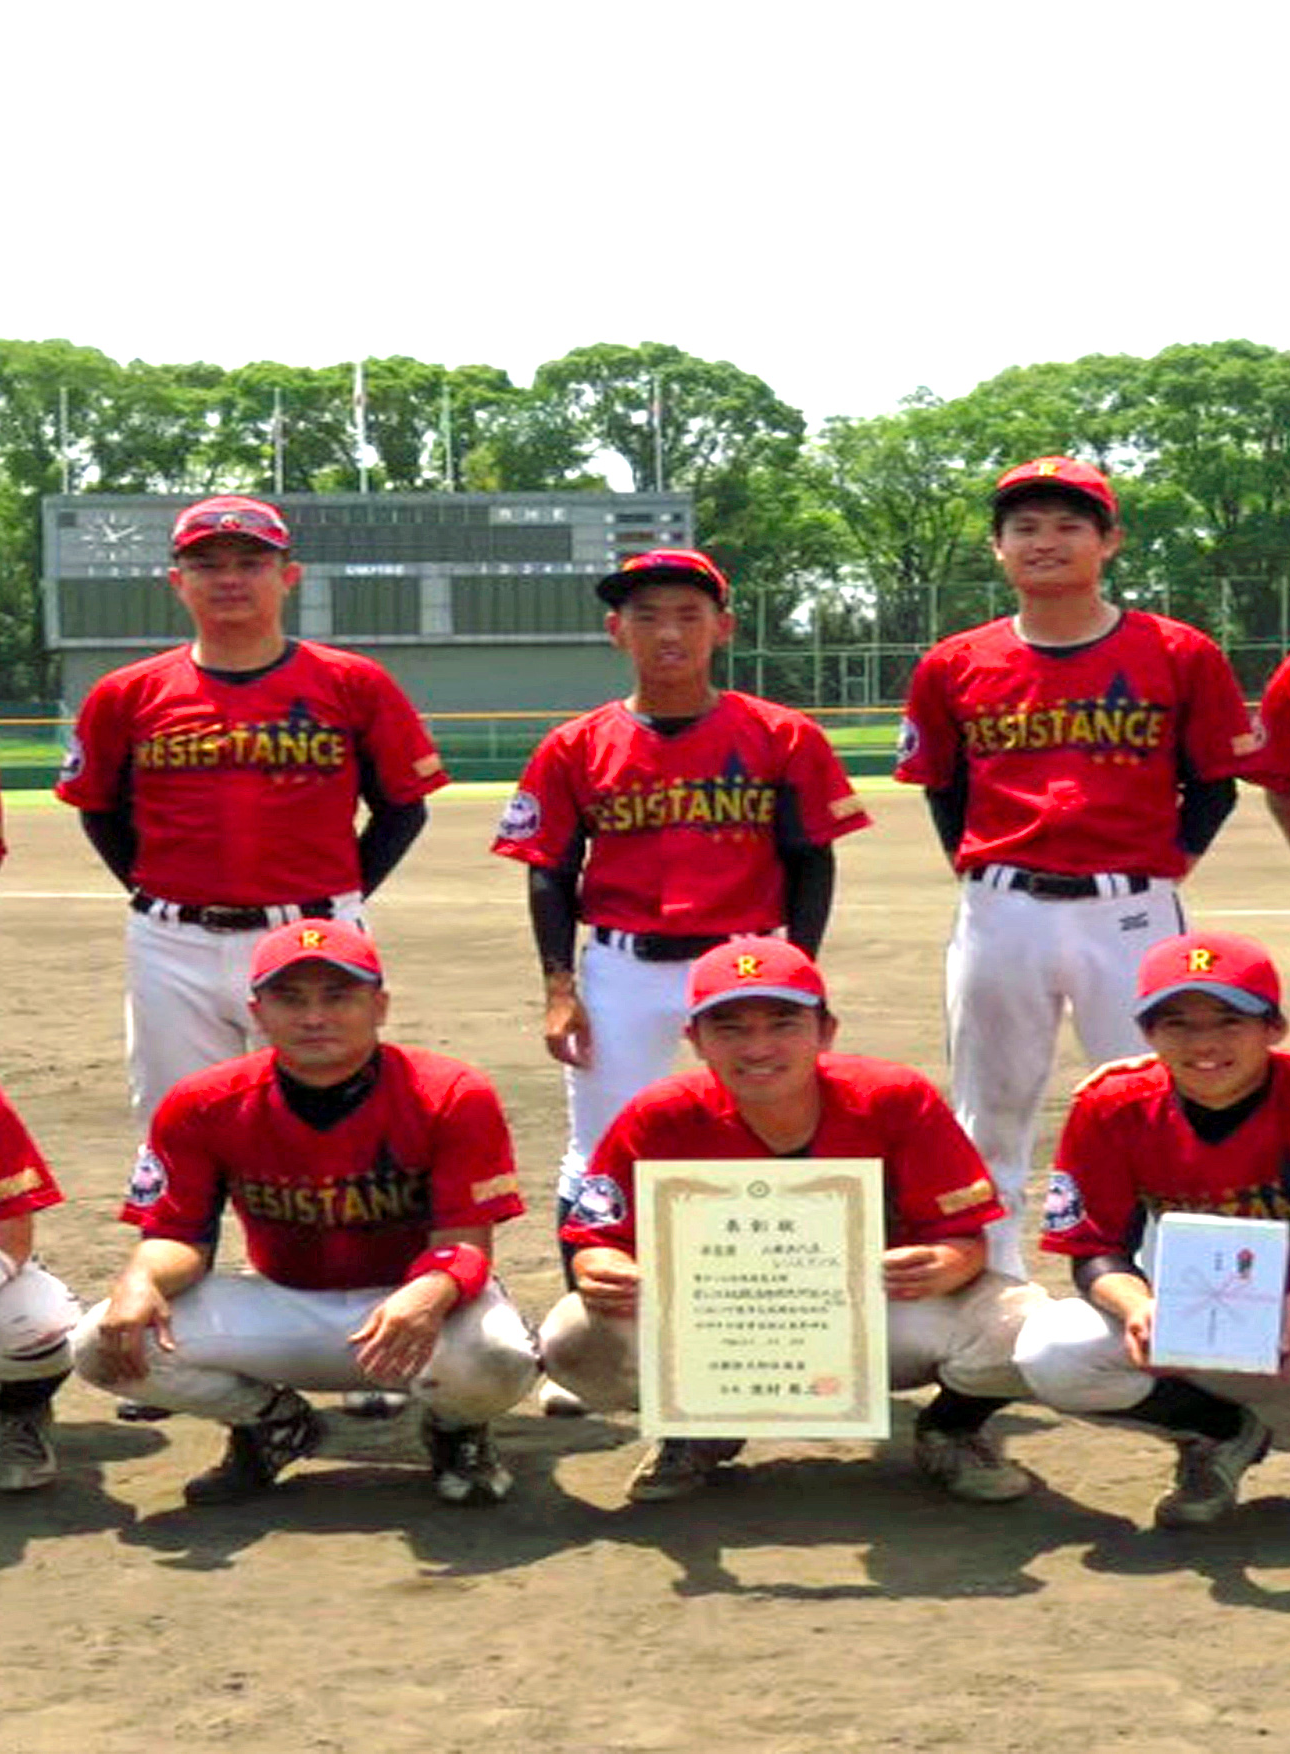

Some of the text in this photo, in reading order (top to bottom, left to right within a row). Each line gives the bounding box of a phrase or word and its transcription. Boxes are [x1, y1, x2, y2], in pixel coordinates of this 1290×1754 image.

[1039, 462, 1057, 477] R
[963, 709, 1165, 757] RESISTANCE
[301, 929, 321, 949] R
[736, 954, 757, 976] R
[1189, 948, 1211, 971] R
